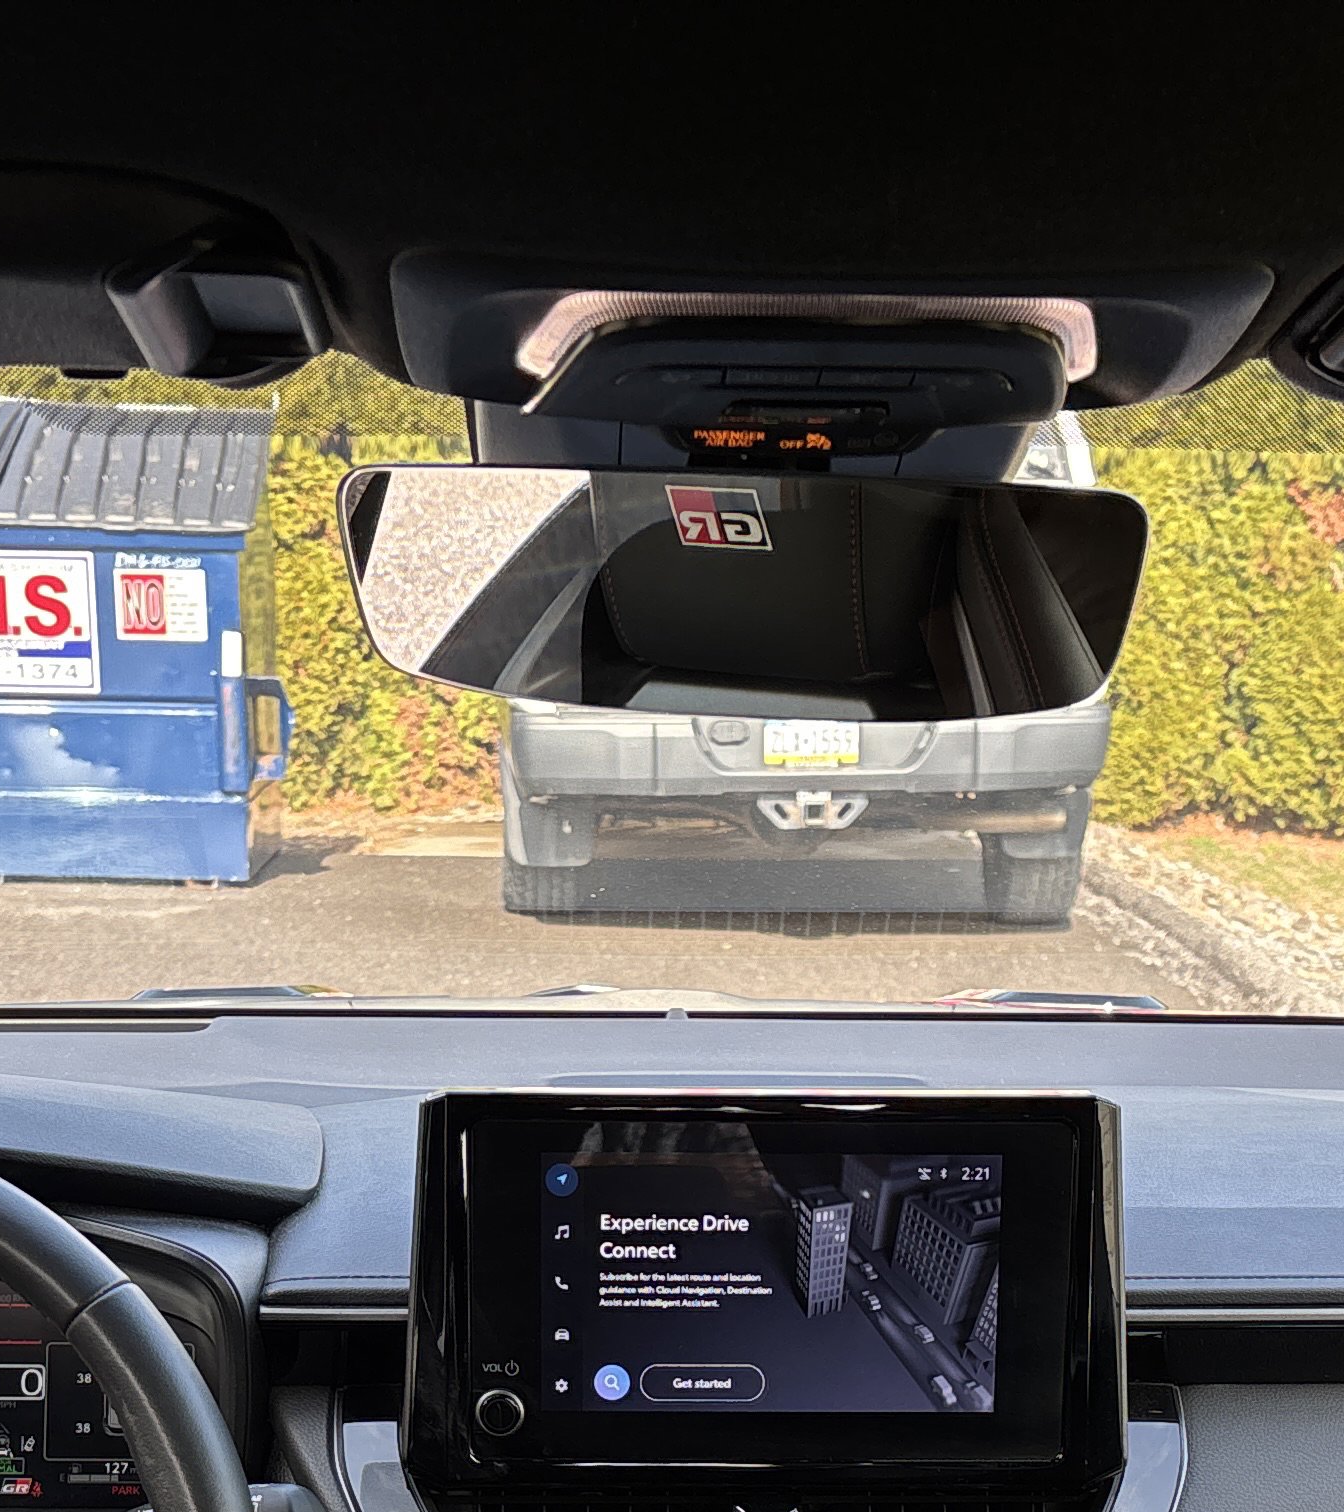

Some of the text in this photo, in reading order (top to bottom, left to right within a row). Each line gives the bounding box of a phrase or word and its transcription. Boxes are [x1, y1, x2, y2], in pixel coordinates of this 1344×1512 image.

[693, 429, 766, 441] PASSENGER
[779, 439, 805, 450] OFF
[121, 578, 166, 631] NO
[961, 1166, 990, 1181] 2:21
[600, 1213, 750, 1234] Experience Drive
[599, 1241, 677, 1259] Connect
[599, 1272, 761, 1282] Subscribe for the latest route and location
[599, 1286, 636, 1296] guidance
[637, 1286, 655, 1296] with
[656, 1286, 681, 1296] Cloud
[727, 1286, 773, 1296] Destination
[623, 1299, 640, 1308] and
[482, 1362, 503, 1373] VOL
[20, 1368, 43, 1397] 0
[76, 1373, 92, 1385] 38
[672, 1378, 732, 1389] Get started
[75, 1422, 91, 1433] 38
[104, 1462, 129, 1475] 127
[111, 1485, 141, 1495] PARK
